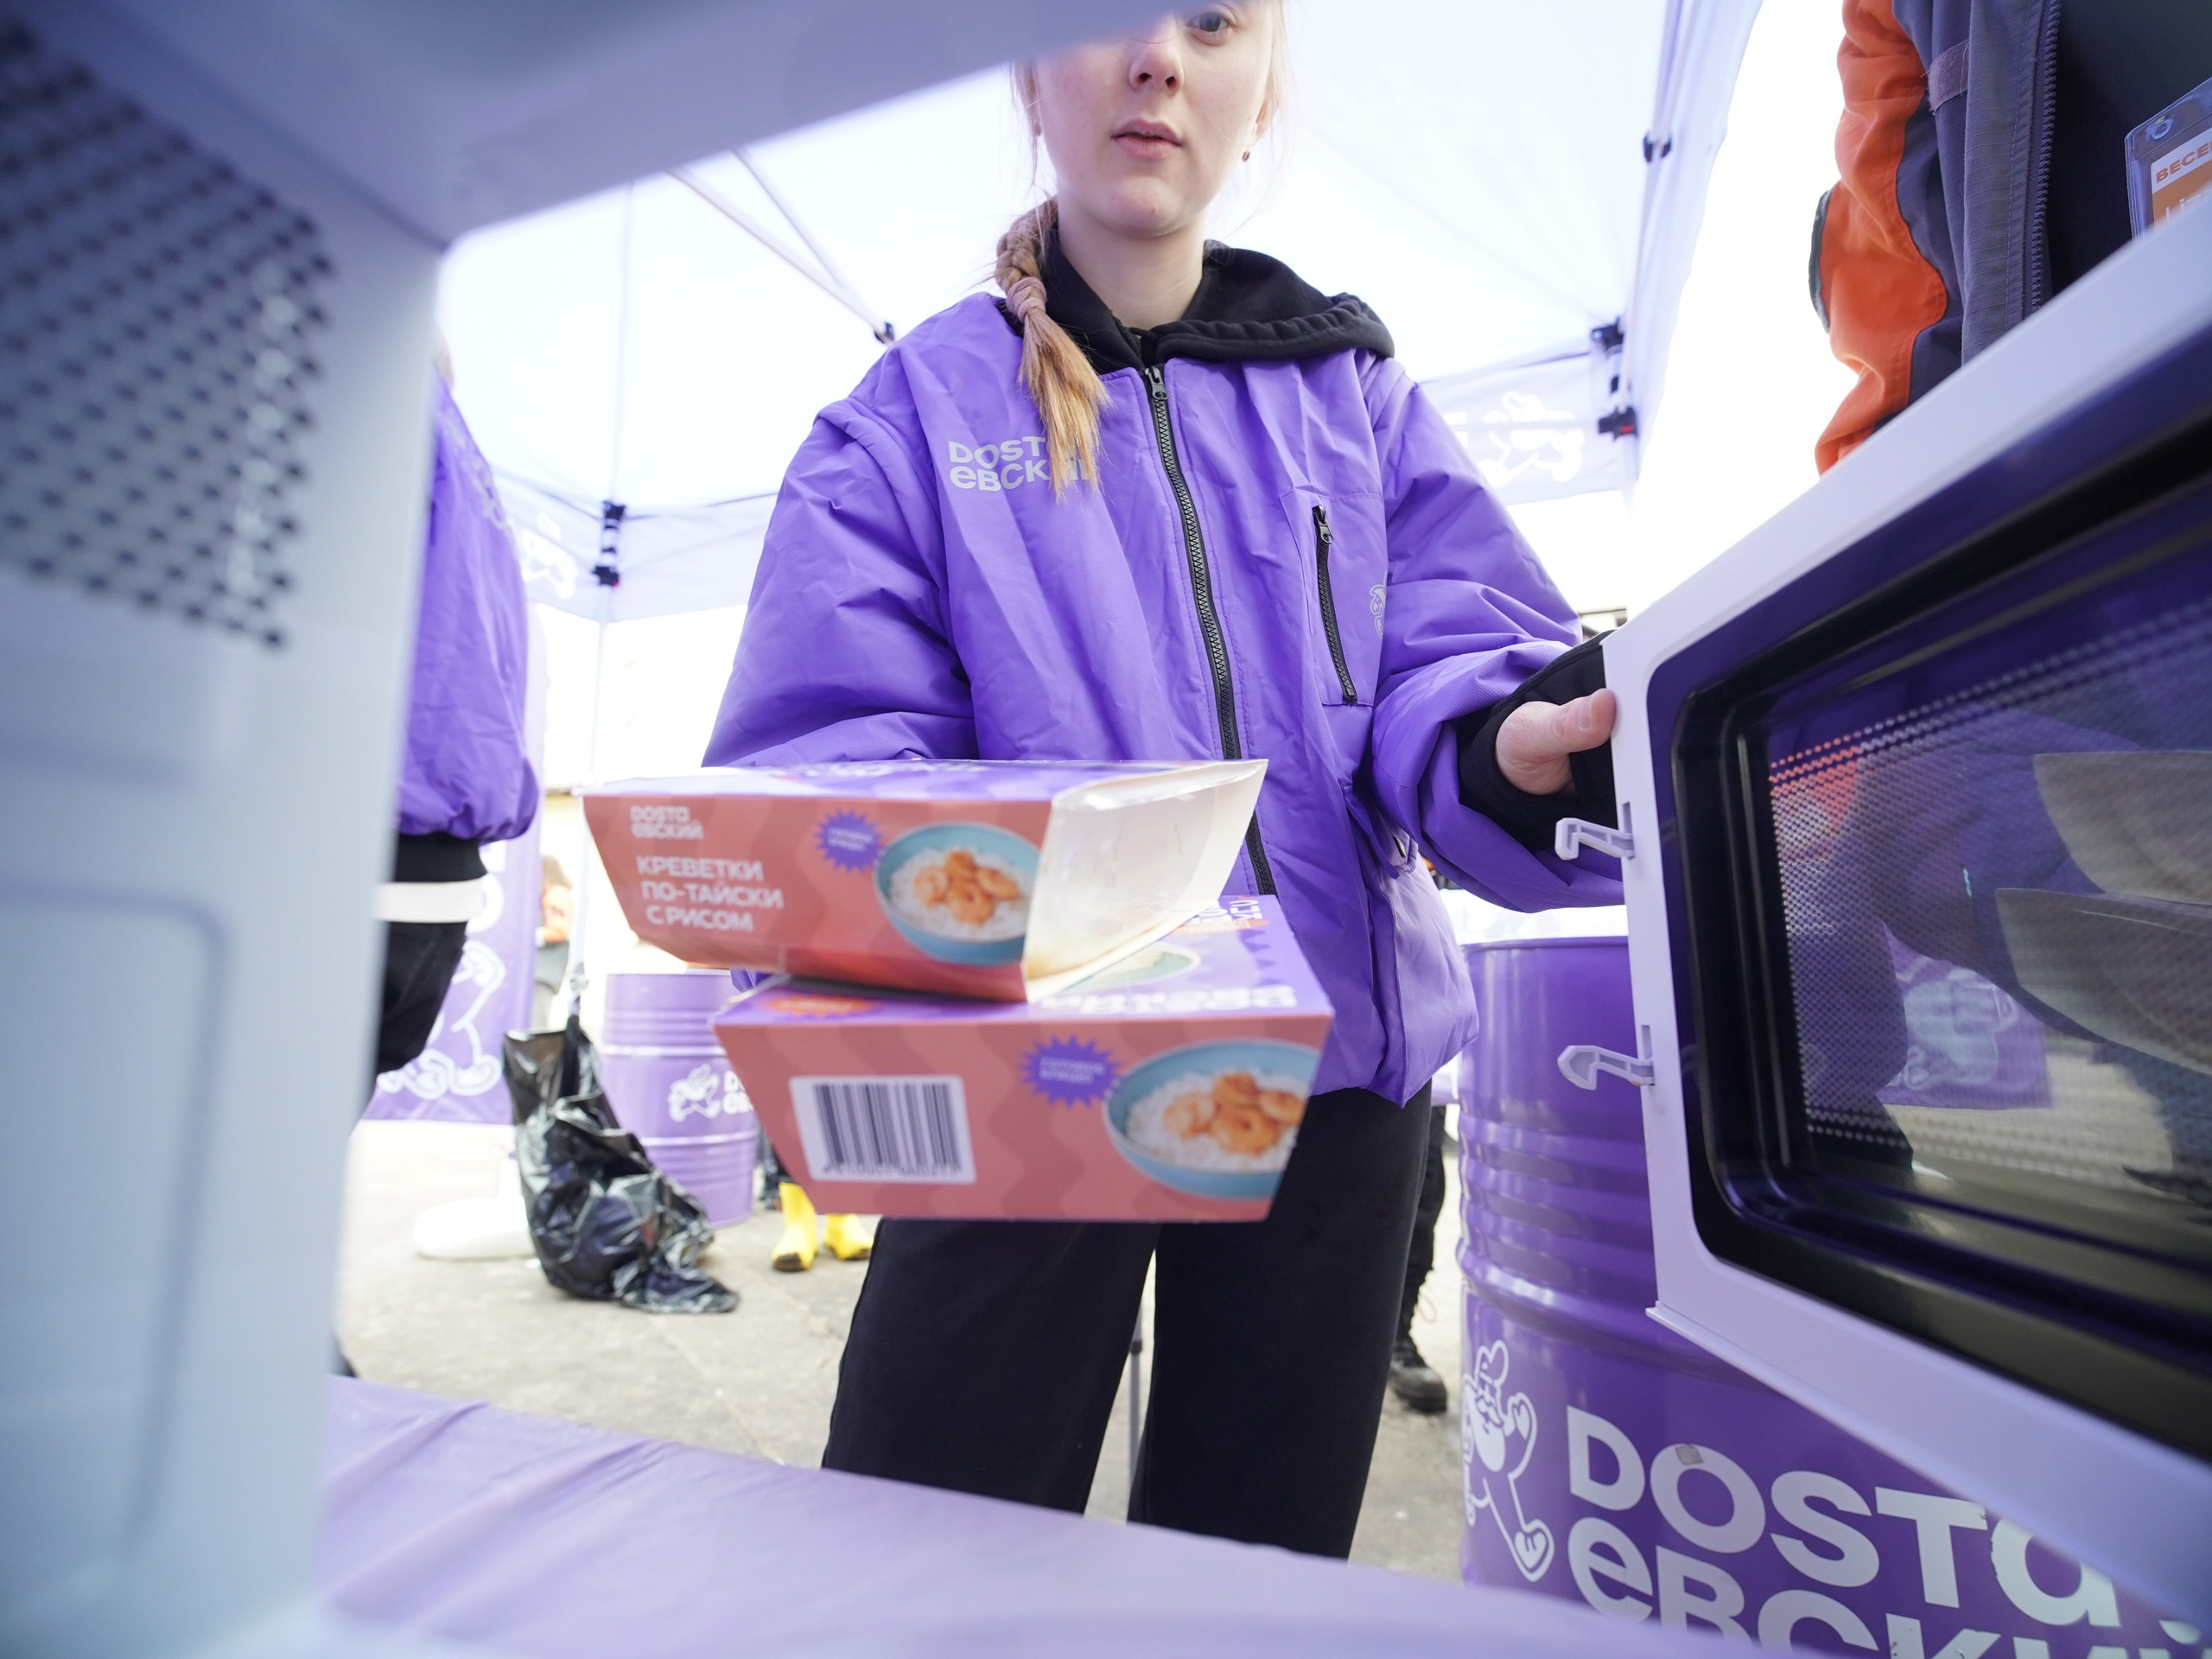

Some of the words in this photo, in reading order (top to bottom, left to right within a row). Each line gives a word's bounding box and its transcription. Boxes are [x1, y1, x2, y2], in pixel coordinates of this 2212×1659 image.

[948, 435, 1047, 468] DOST
[636, 855, 765, 882] КРЕВЕТКИ
[640, 880, 785, 910] ПО-ТАЙСКИ
[645, 905, 664, 925] С
[665, 905, 754, 932] РИСОМ
